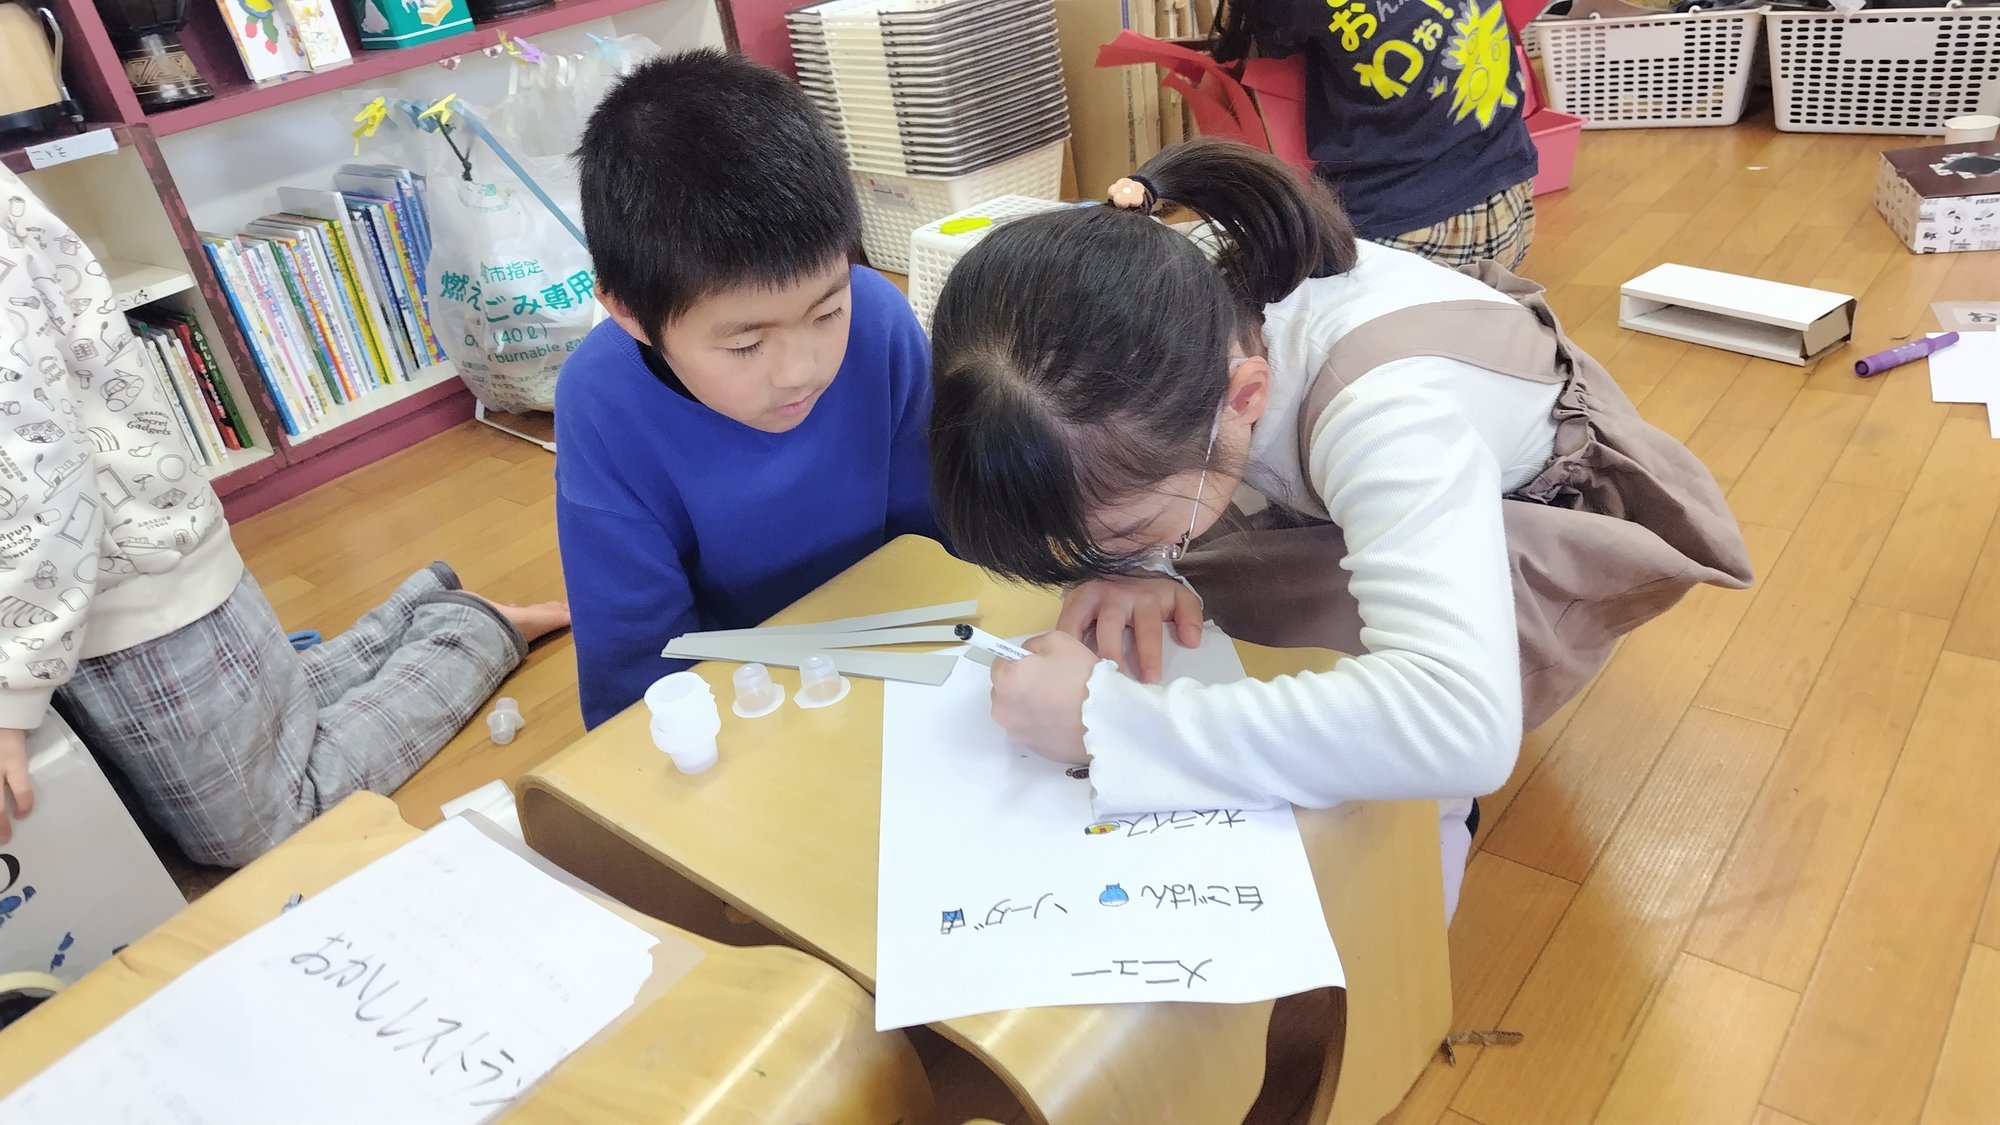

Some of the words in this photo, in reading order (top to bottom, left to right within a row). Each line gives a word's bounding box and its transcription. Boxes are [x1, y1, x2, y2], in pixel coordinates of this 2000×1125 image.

[126, 420, 172, 436] Gadgets
[136, 416, 168, 428] Secret
[973, 892, 1068, 931] ソーダ
[1140, 883, 1265, 912] 白ごはん
[1071, 958, 1213, 989] メニュー
